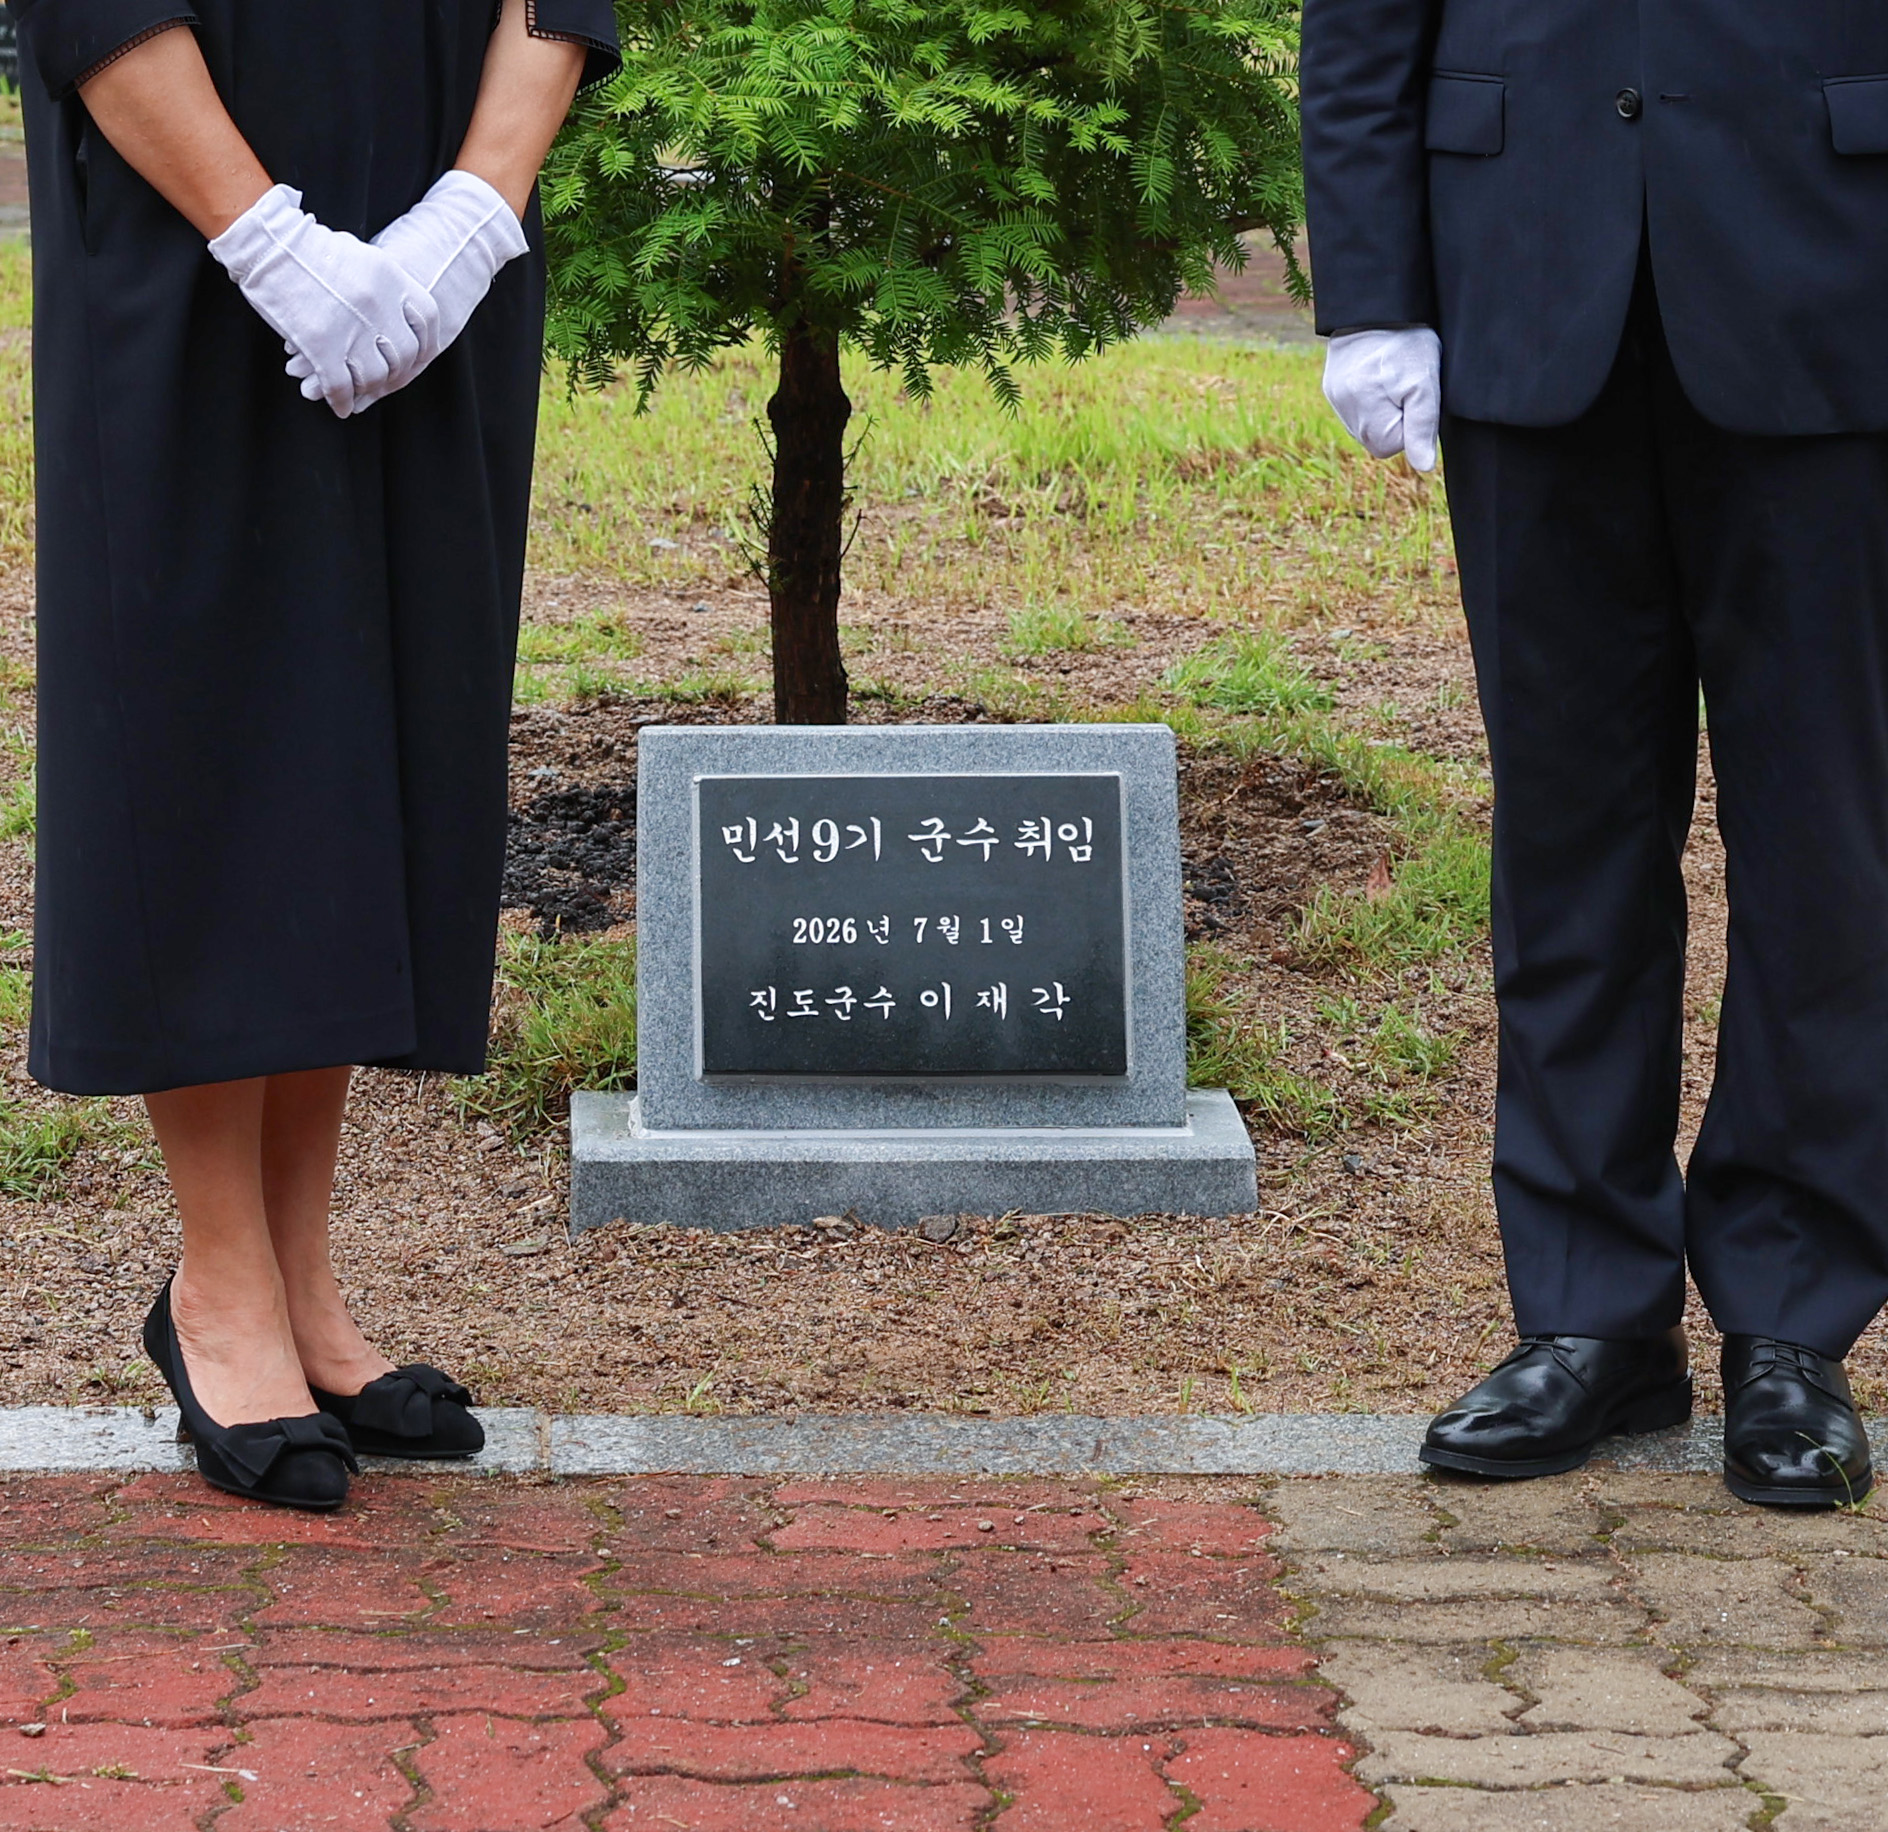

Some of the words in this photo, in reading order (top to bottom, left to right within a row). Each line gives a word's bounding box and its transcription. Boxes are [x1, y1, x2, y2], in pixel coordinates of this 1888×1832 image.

[721, 816, 881, 864] 민선9기
[907, 816, 1000, 863] 군수
[1013, 816, 1093, 863] 취임
[748, 985, 897, 1021] 진도군수
